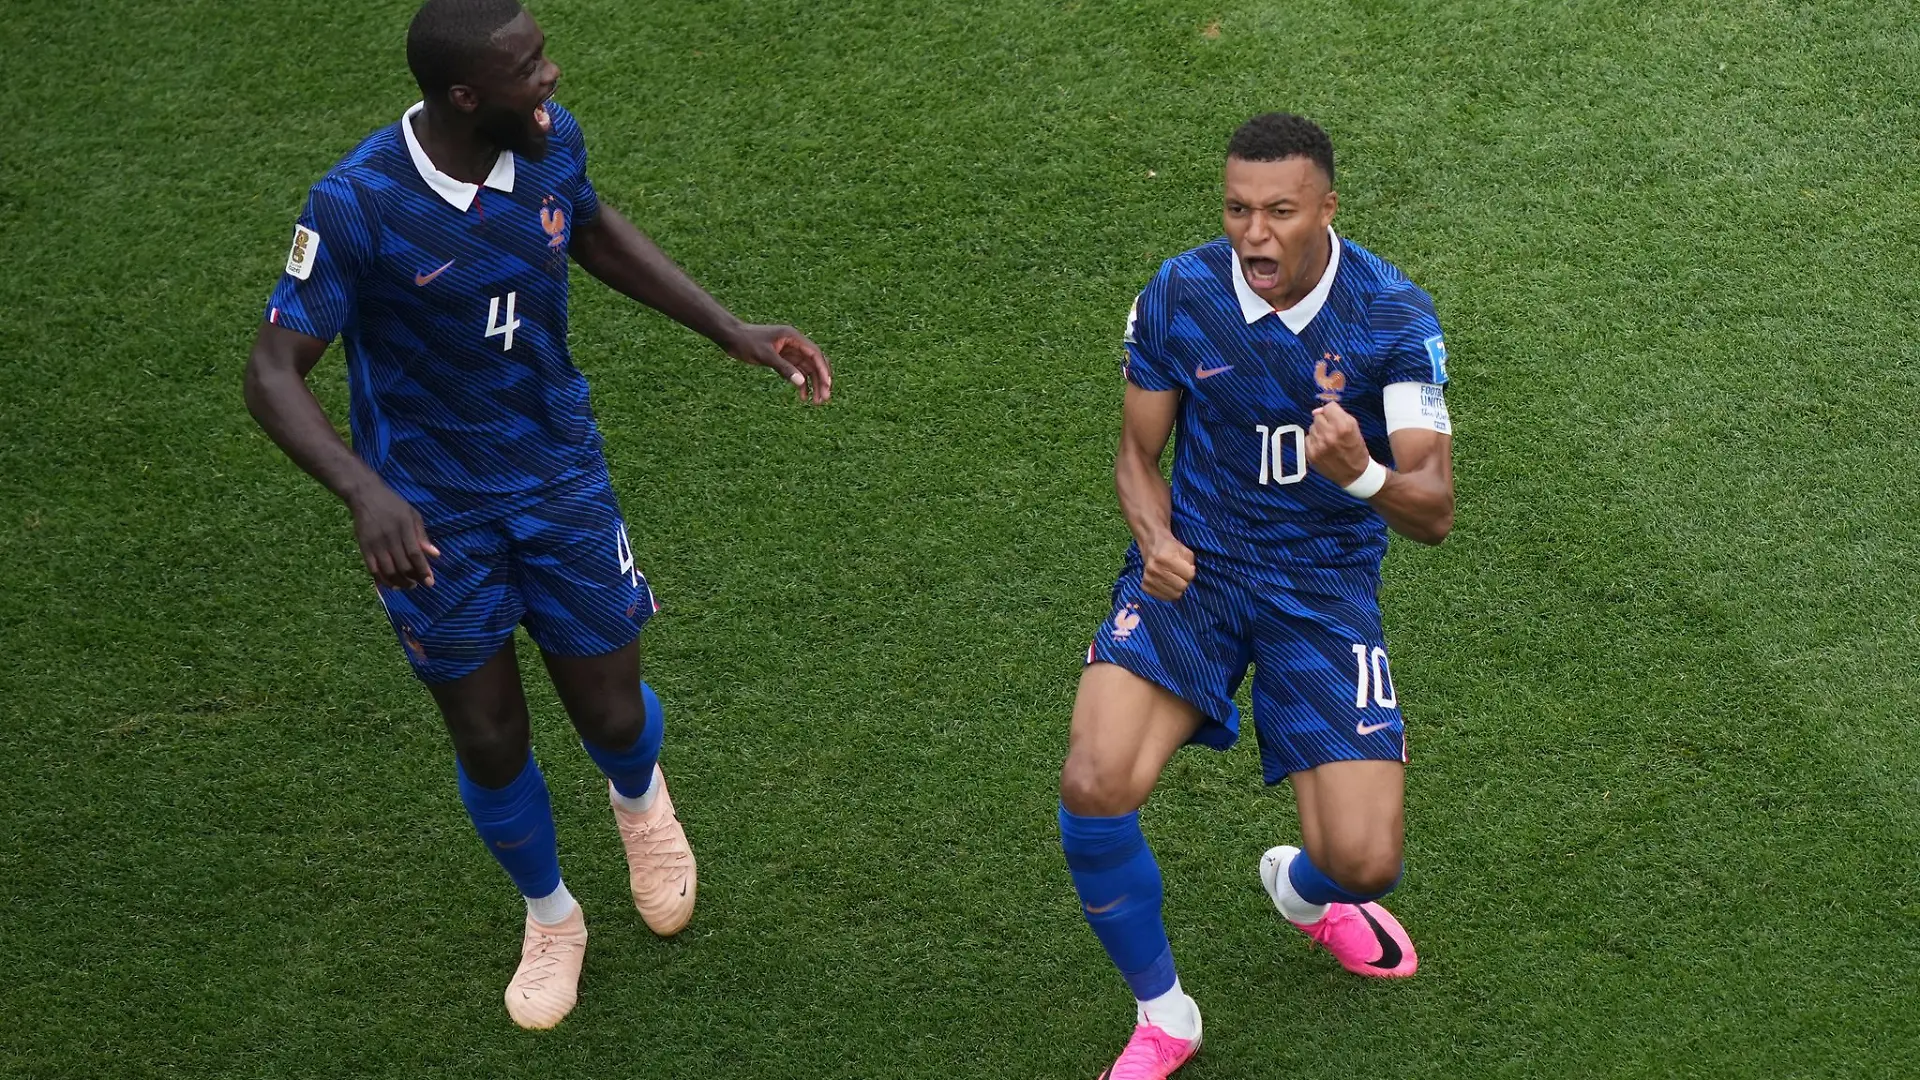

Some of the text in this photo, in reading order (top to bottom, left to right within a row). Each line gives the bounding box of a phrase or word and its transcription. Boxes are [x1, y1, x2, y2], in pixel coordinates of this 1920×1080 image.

[484, 291, 520, 352] 4
[1256, 424, 1307, 485] 10
[616, 522, 638, 588] 4
[1352, 643, 1397, 709] 10
